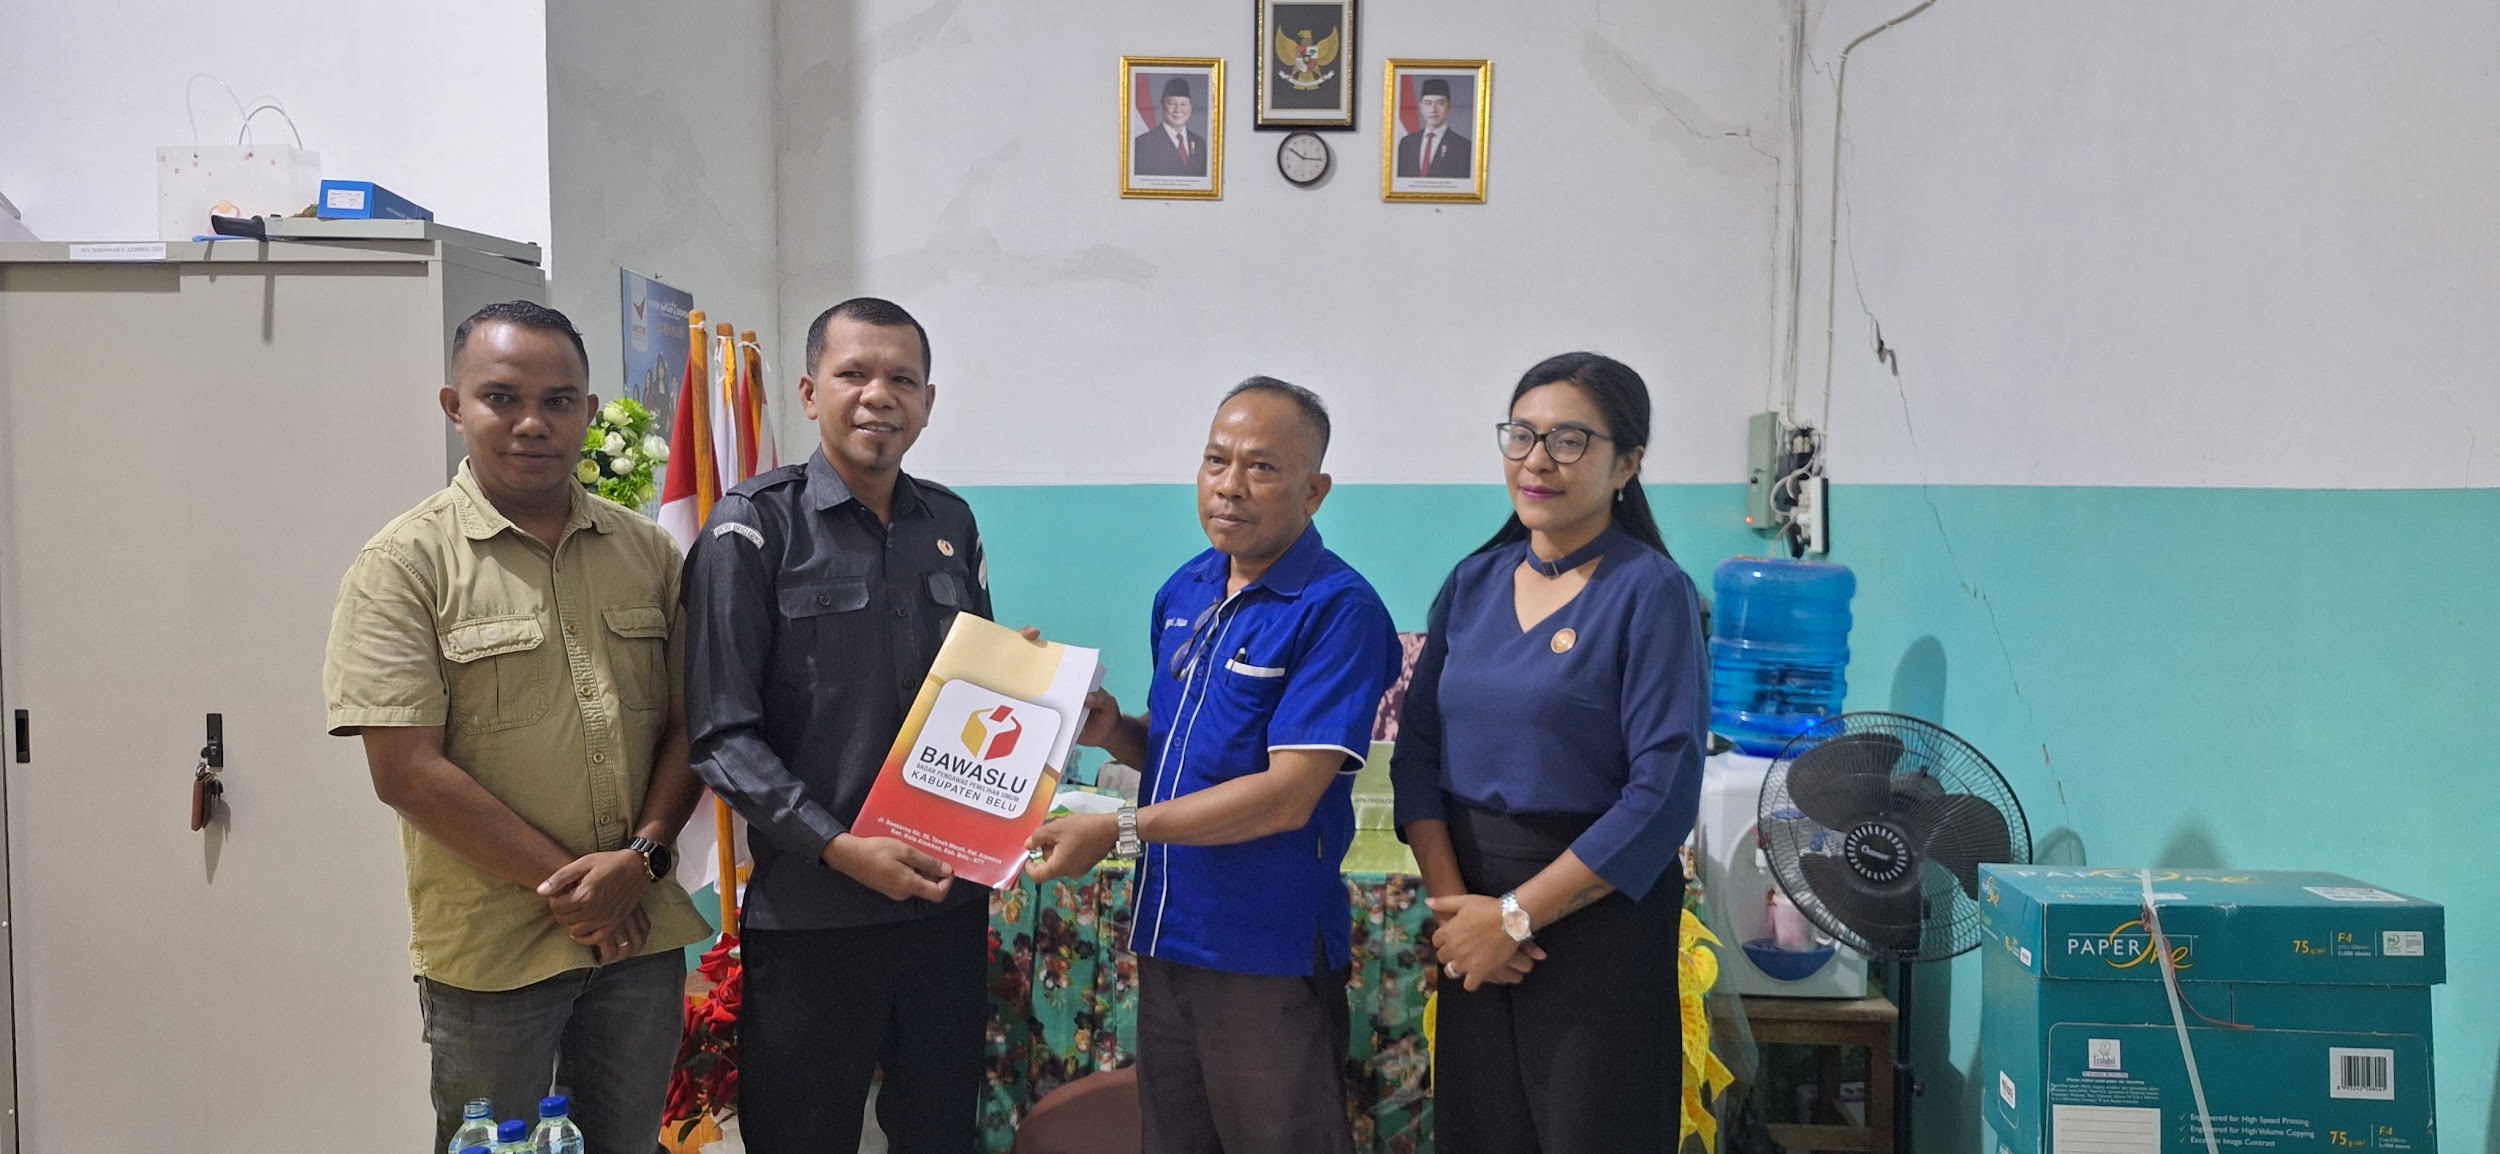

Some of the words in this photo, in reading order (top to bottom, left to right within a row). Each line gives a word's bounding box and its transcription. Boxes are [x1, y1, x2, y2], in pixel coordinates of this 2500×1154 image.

[920, 746, 1027, 794] BAWASLU
[915, 762, 936, 774] BADAN
[936, 768, 968, 786] PENGAWAS
[969, 781, 1001, 797] PEMILIHAN
[1001, 791, 1020, 802] UMUM
[911, 770, 981, 801] KABUPATEN
[985, 796, 1017, 812] BELU
[2337, 932, 2353, 943] F4
[2067, 938, 2142, 956] PAPER
[2292, 940, 2310, 954] 75
[2229, 1114, 2240, 1122] for
[2241, 1115, 2258, 1124] High
[2259, 1116, 2281, 1125] Speed
[2281, 1117, 2310, 1127] Printing
[2190, 1124, 2228, 1134] Engered
[2229, 1126, 2240, 1134] for
[2241, 1127, 2258, 1136] High
[2258, 1127, 2284, 1136] Volume
[2285, 1128, 2315, 1139] Copying
[2330, 1130, 2347, 1146] 75
[2379, 1126, 2393, 1136] F4
[2222, 1137, 2243, 1147] Image
[2244, 1138, 2276, 1147] Contrast
